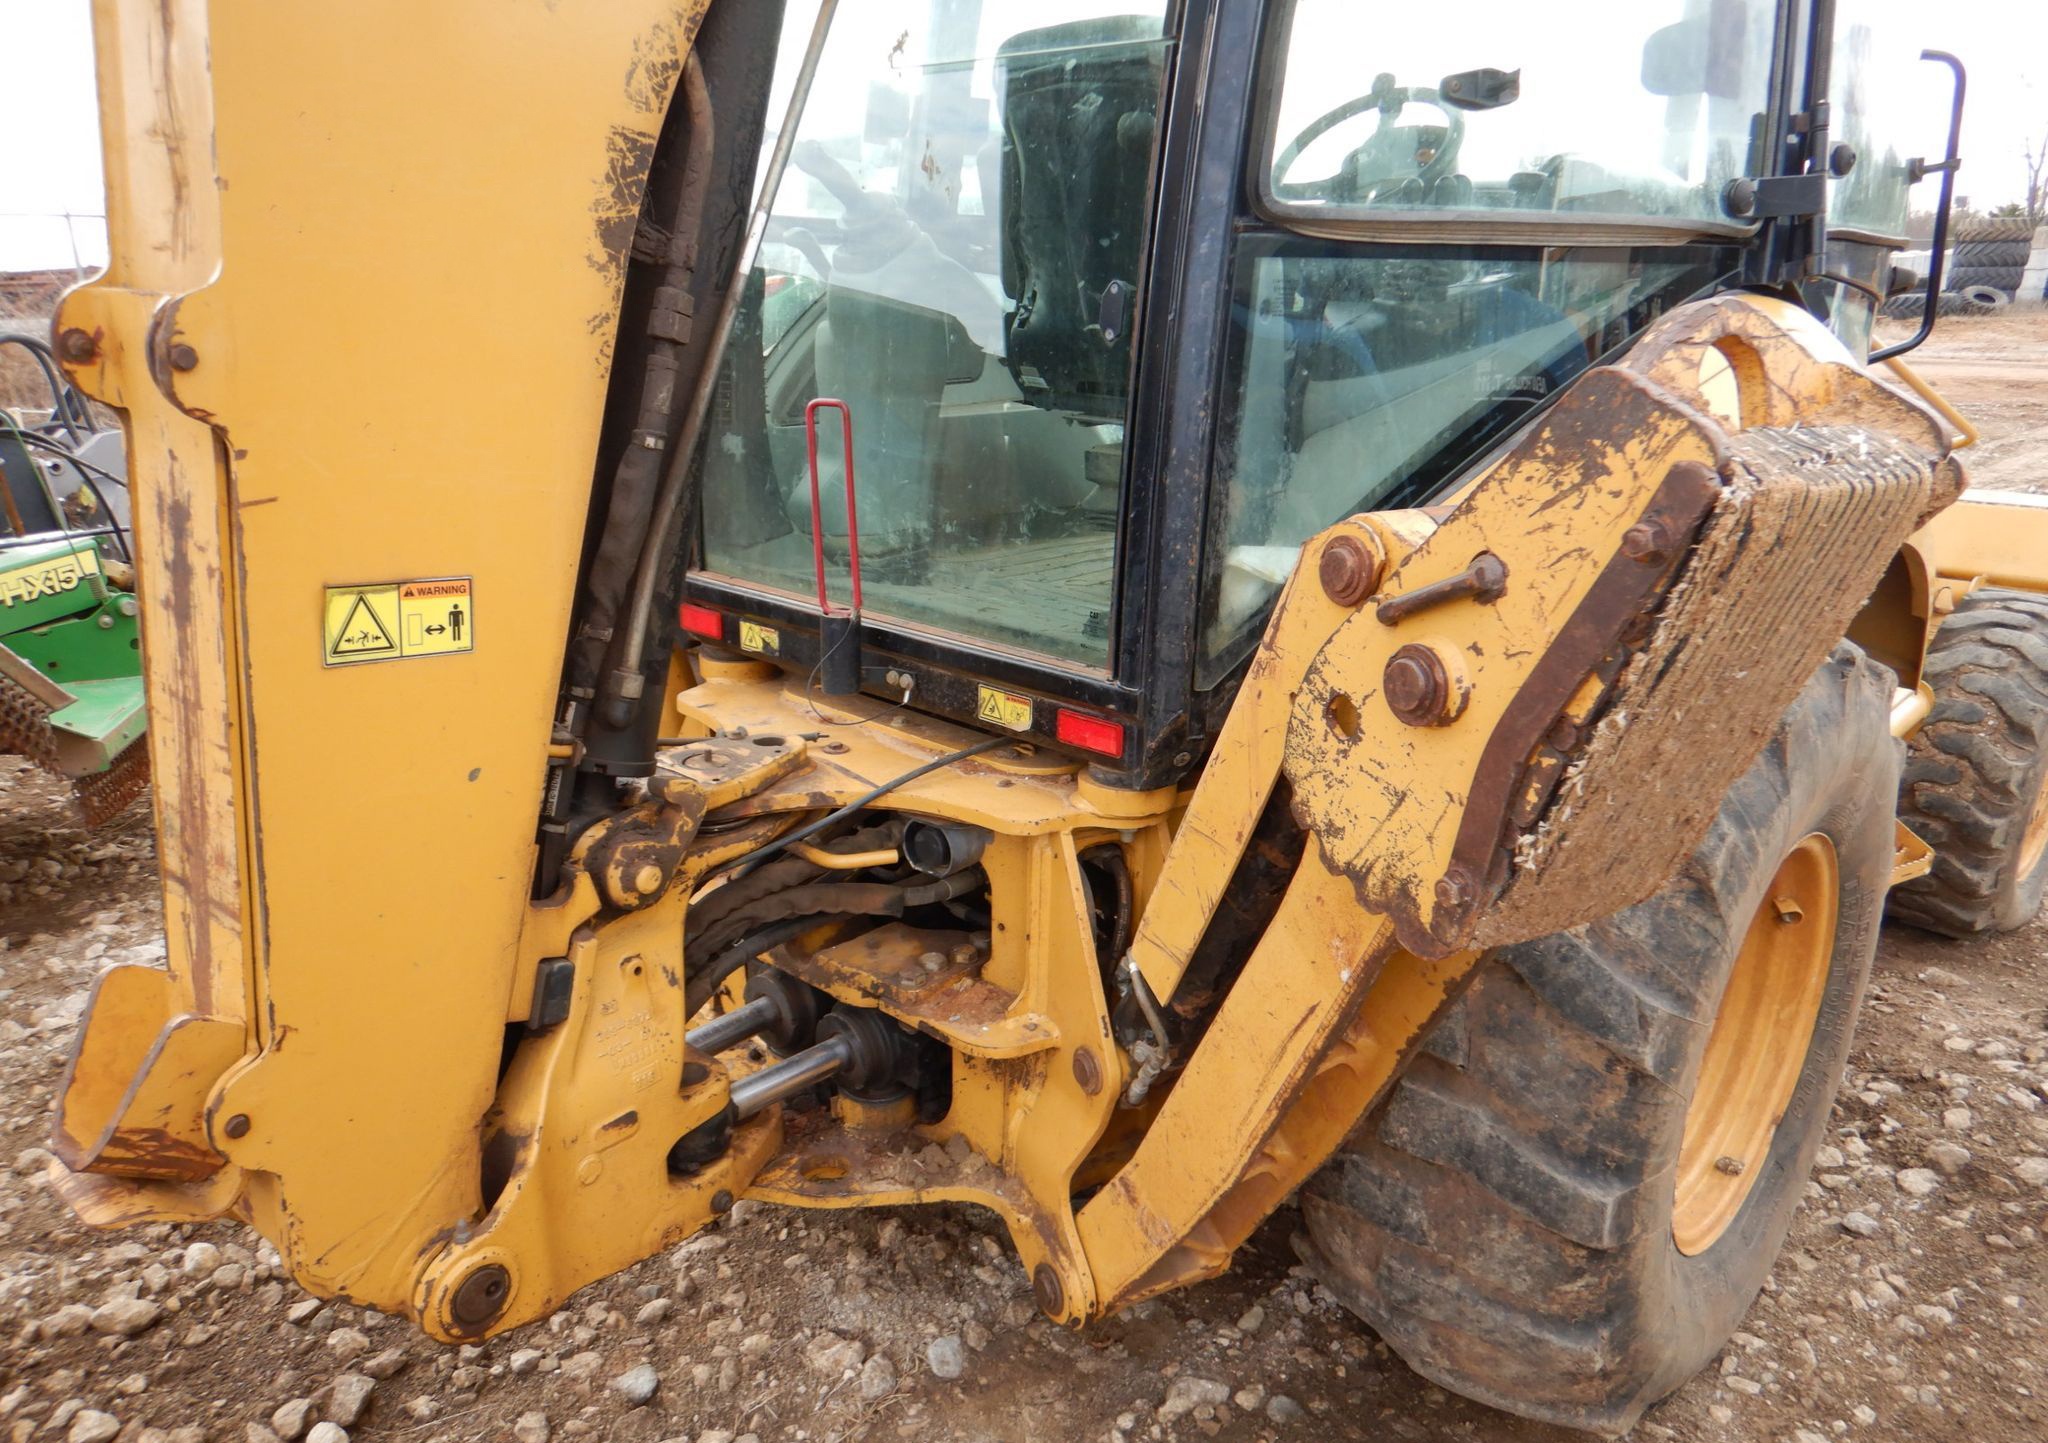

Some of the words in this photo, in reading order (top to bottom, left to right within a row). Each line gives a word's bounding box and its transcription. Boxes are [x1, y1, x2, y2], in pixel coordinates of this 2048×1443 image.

[2, 563, 79, 607] HX15
[416, 584, 467, 598] WARNING
[1010, 696, 1030, 706] WARNING
